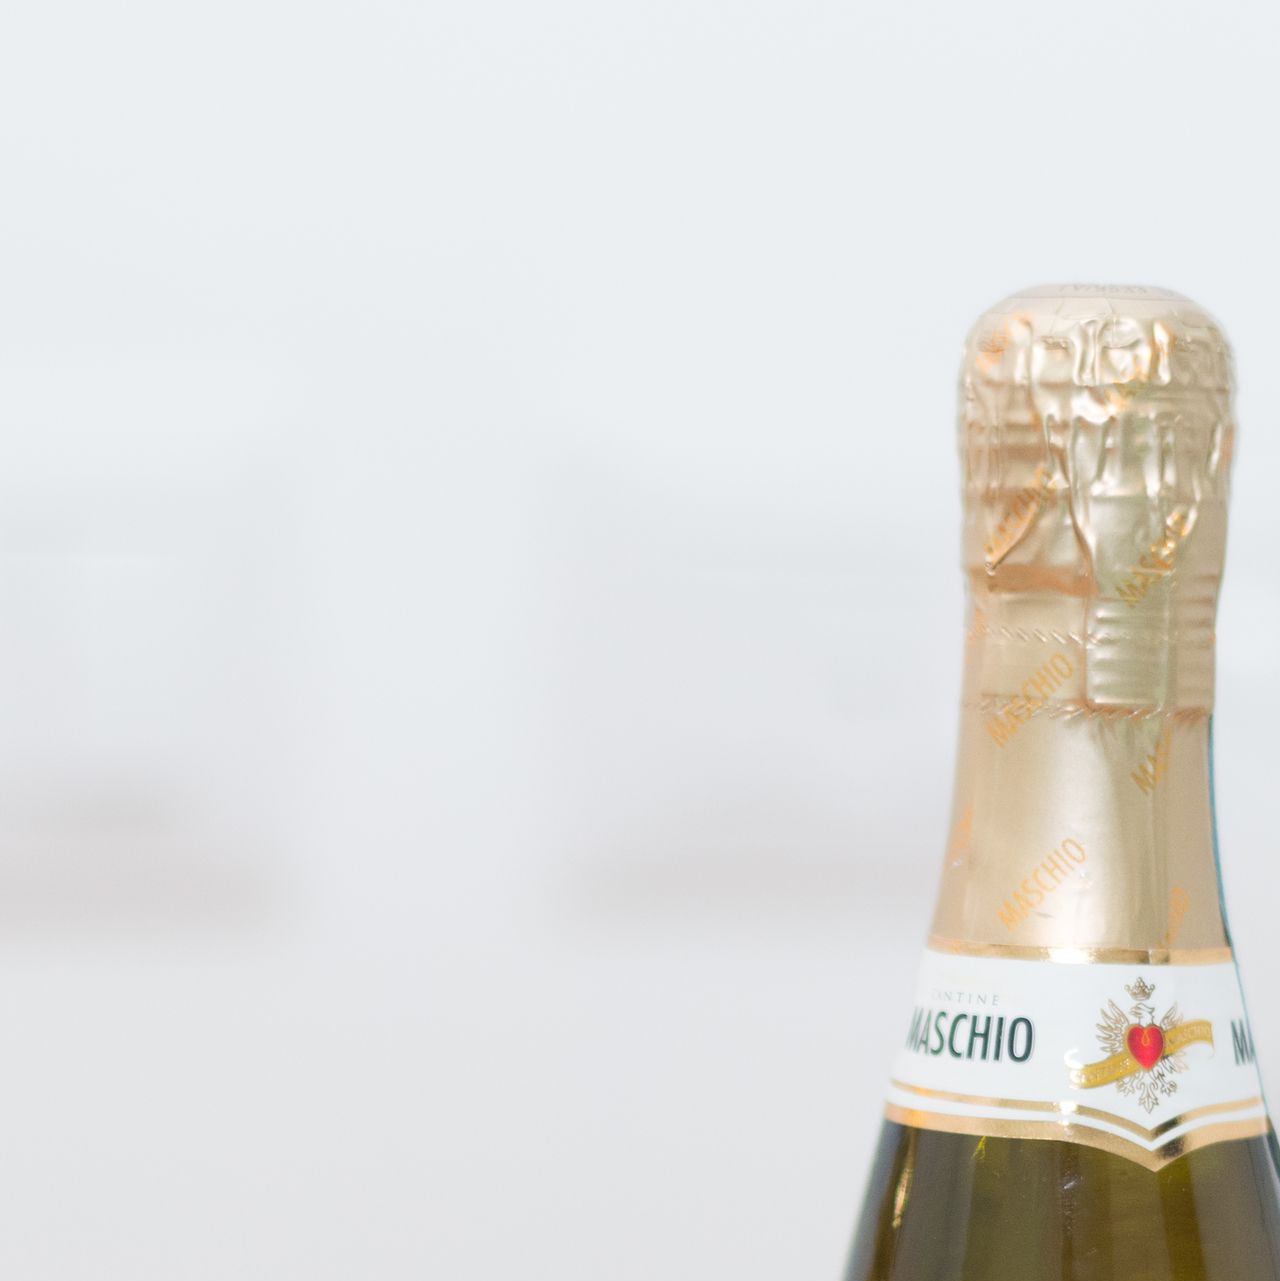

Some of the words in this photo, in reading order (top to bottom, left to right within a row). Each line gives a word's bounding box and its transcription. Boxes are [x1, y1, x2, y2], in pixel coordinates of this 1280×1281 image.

[985, 652, 1073, 748] MASCHIO
[997, 837, 1088, 933] MASCHIO
[905, 1006, 1035, 1063] MASCHIO
